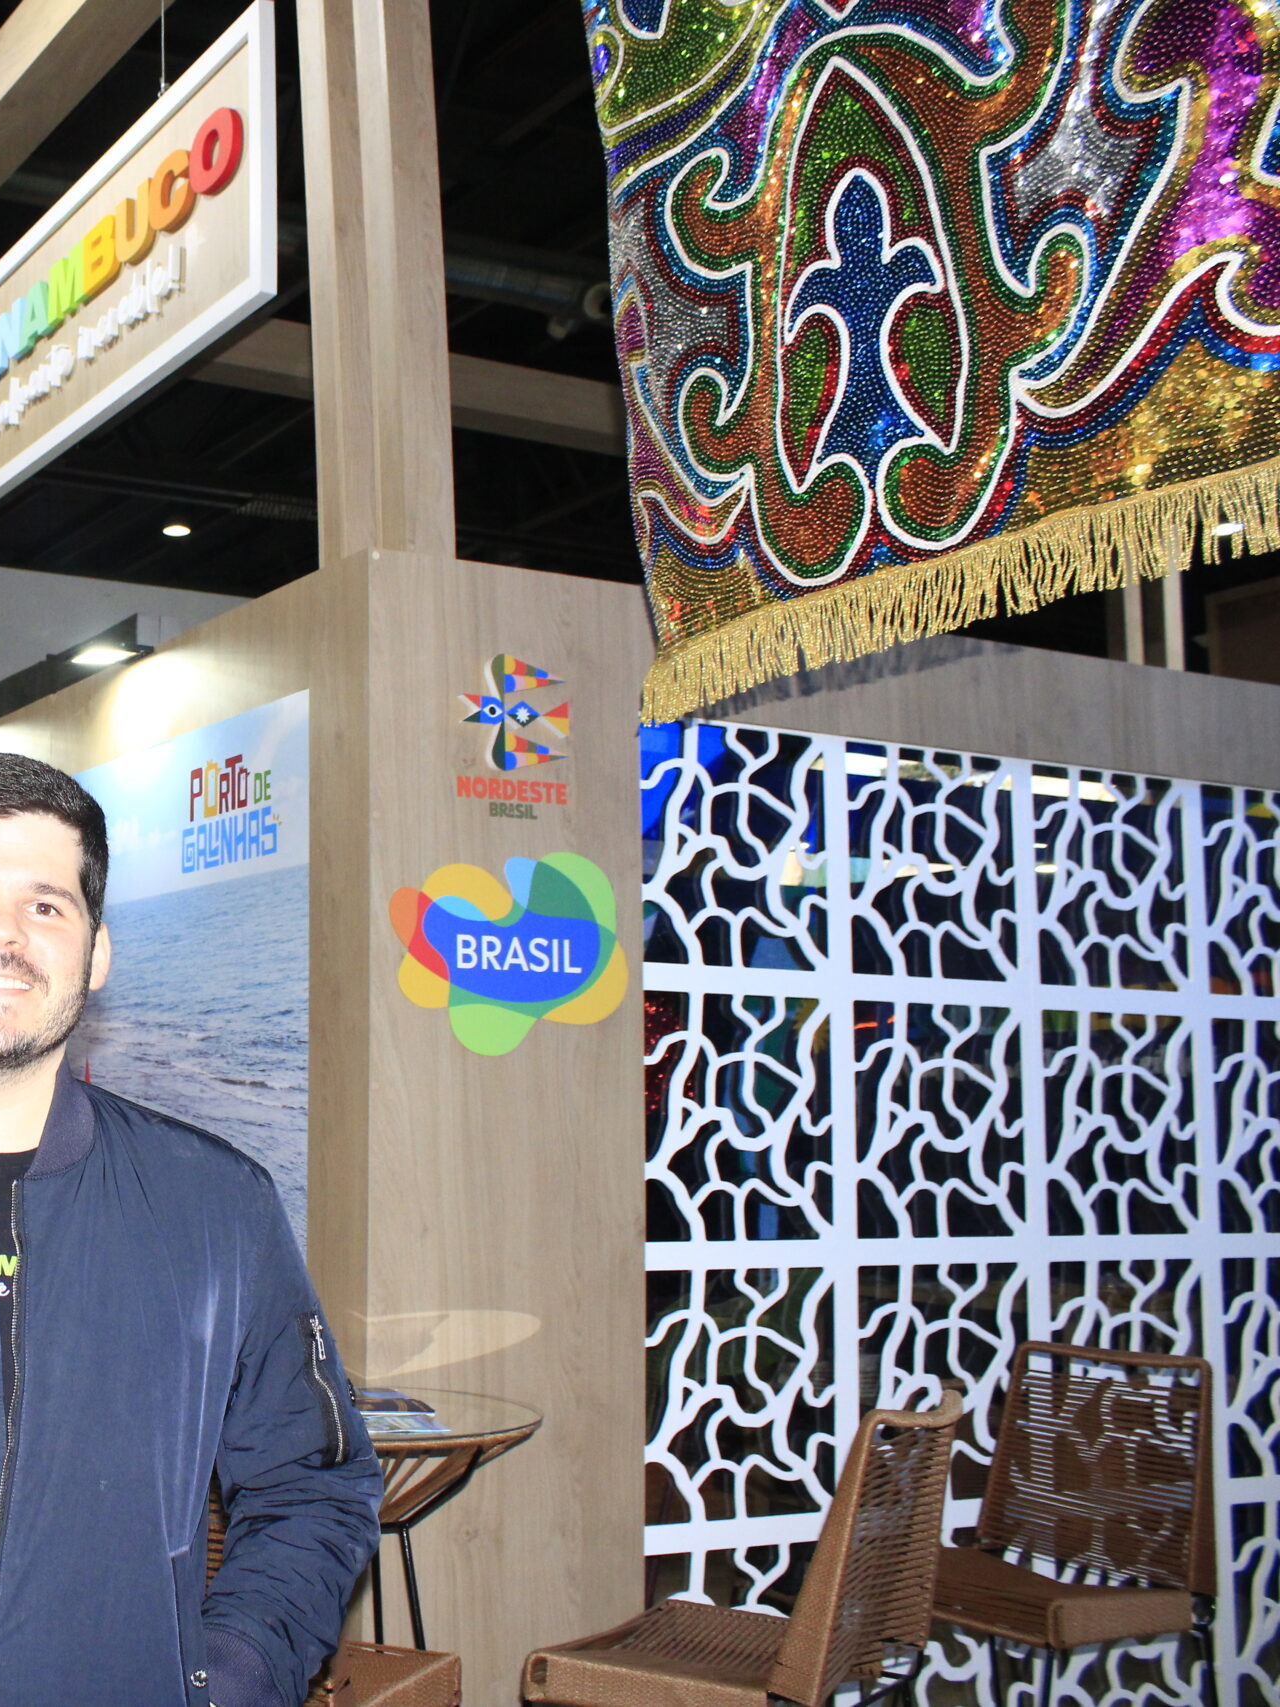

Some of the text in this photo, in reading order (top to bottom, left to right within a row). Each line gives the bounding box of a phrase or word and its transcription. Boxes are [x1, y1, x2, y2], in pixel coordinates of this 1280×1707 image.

[190, 754, 271, 822] PORTO DE
[456, 775, 568, 805] NORDESTE
[489, 802, 538, 820] BRASIL
[182, 806, 277, 874] GALINHAS
[456, 934, 582, 974] BRASIL
